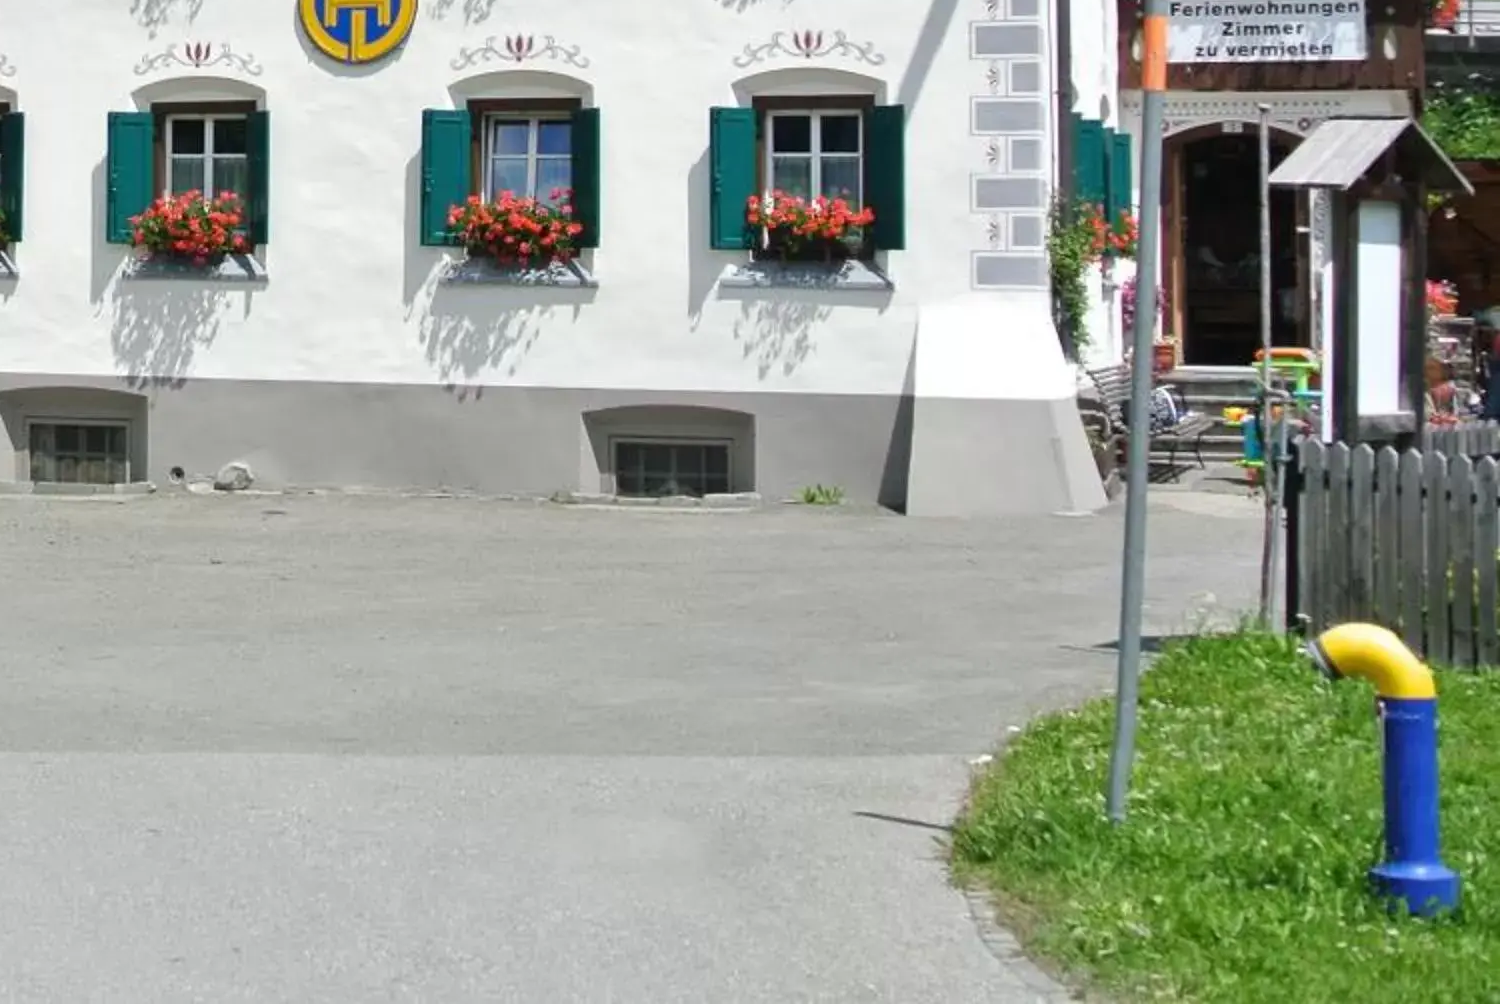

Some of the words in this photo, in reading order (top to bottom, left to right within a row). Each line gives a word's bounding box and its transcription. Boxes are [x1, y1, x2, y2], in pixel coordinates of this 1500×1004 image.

[1169, 0, 1361, 18] Ferienwohnungen
[1221, 21, 1305, 37] Zimmer
[1195, 46, 1218, 58] zu
[1226, 42, 1334, 58] vermieten
